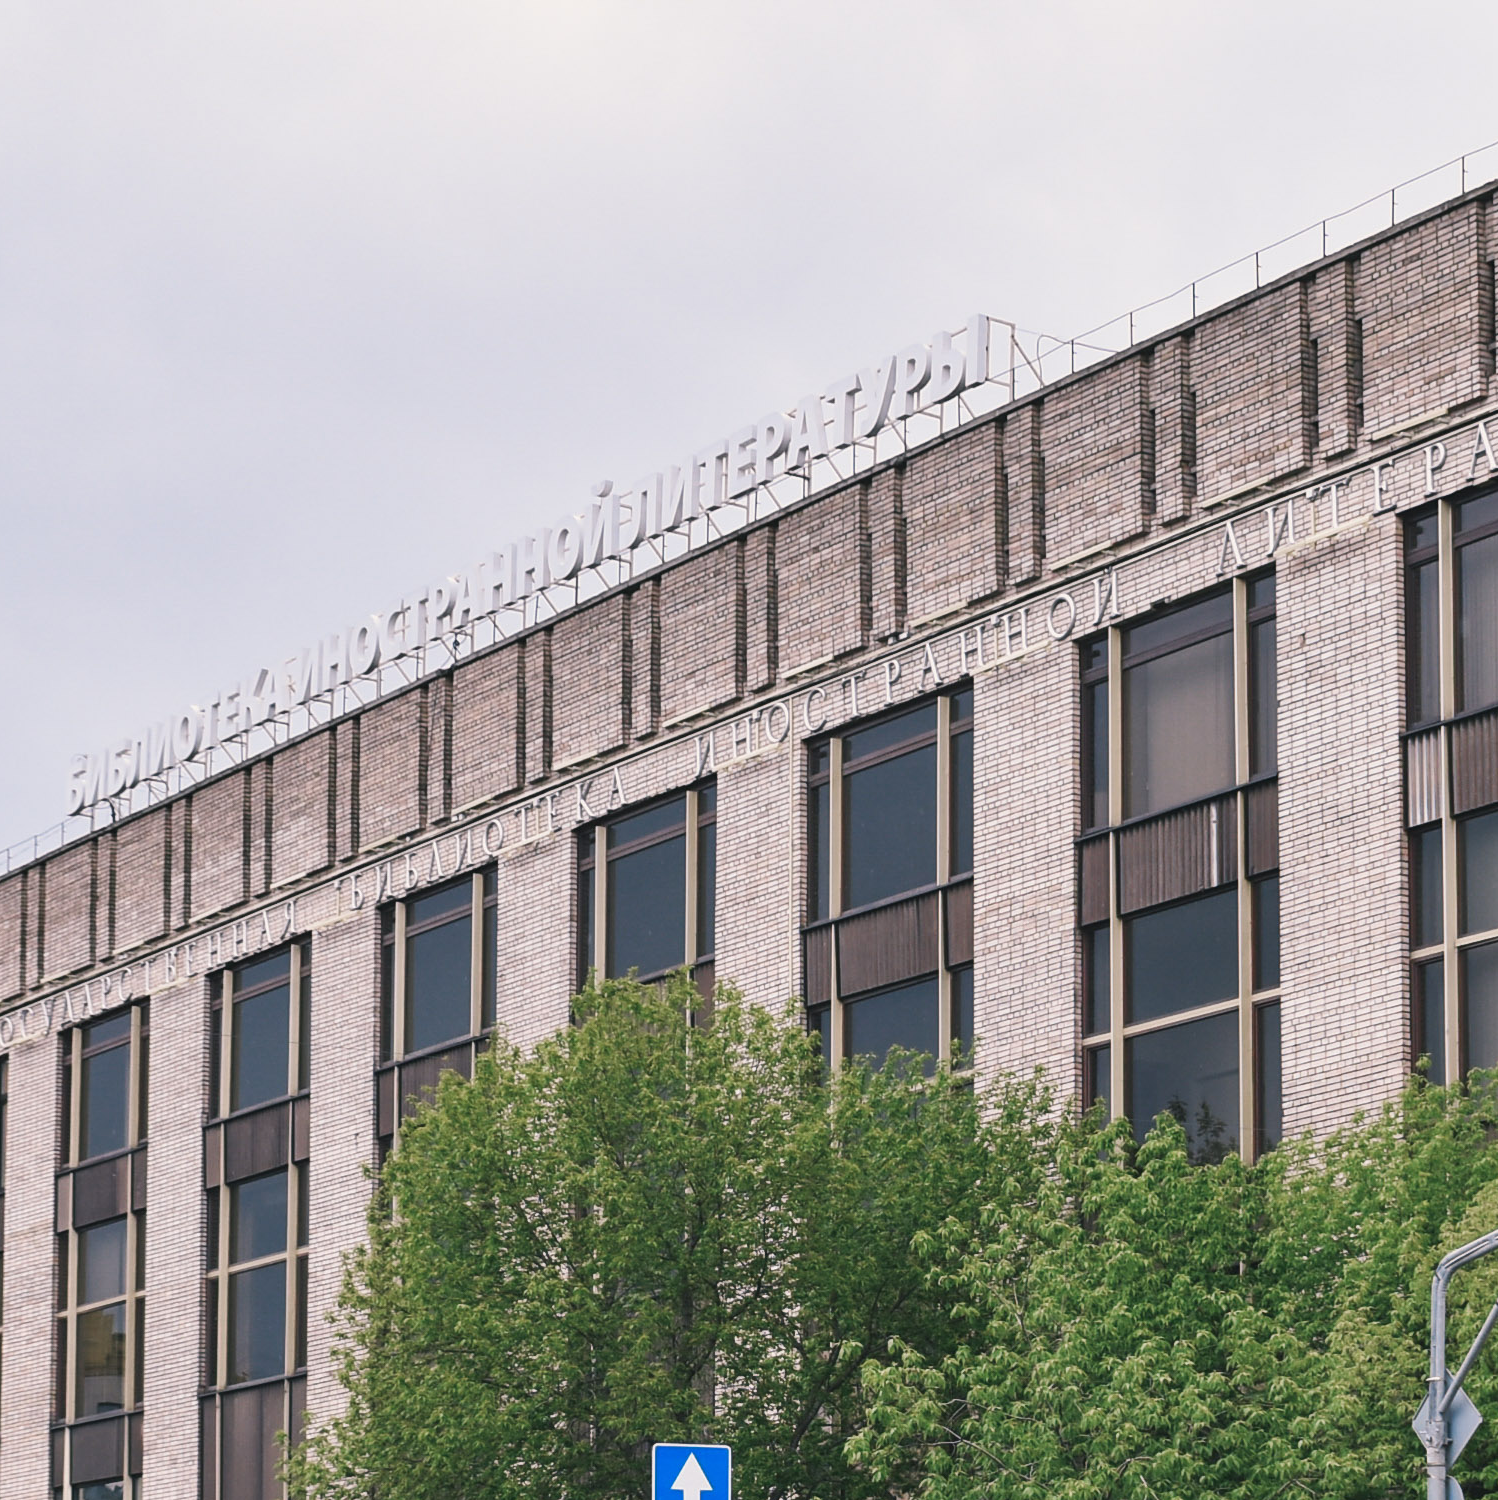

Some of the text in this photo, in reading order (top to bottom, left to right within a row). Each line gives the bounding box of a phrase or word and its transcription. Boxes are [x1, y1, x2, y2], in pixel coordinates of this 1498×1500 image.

[68, 313, 989, 816] БИБЛИОТЕКА ИНОСТРАННОЙ ЛИТЕРАТУРЫ
[349, 765, 627, 911] БИБЛИОТЕКА
[693, 566, 1121, 778] ИНОСТРАННОЙ
